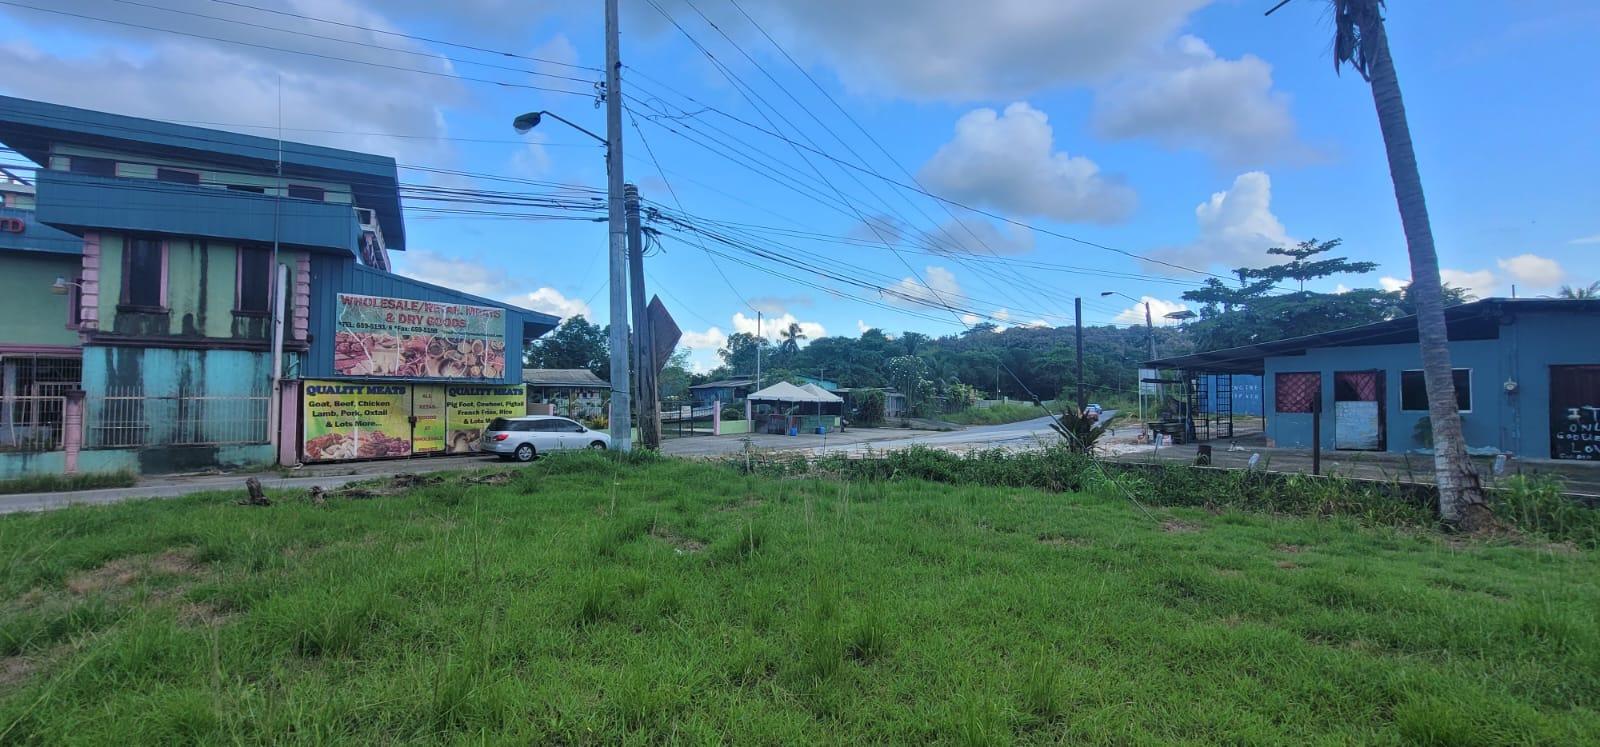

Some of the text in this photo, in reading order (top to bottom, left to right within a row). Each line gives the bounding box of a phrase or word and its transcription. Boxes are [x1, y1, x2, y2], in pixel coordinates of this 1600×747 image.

[385, 312, 467, 328] & DRY GOODS
[306, 385, 406, 396] QUALITY MEATS
[448, 388, 524, 397] QUALITY MEATS
[308, 400, 332, 408] Goat,
[334, 400, 356, 408] Beef,
[446, 401, 458, 409] Pig
[312, 410, 339, 418] Lamb,
[341, 409, 363, 417] Pork,
